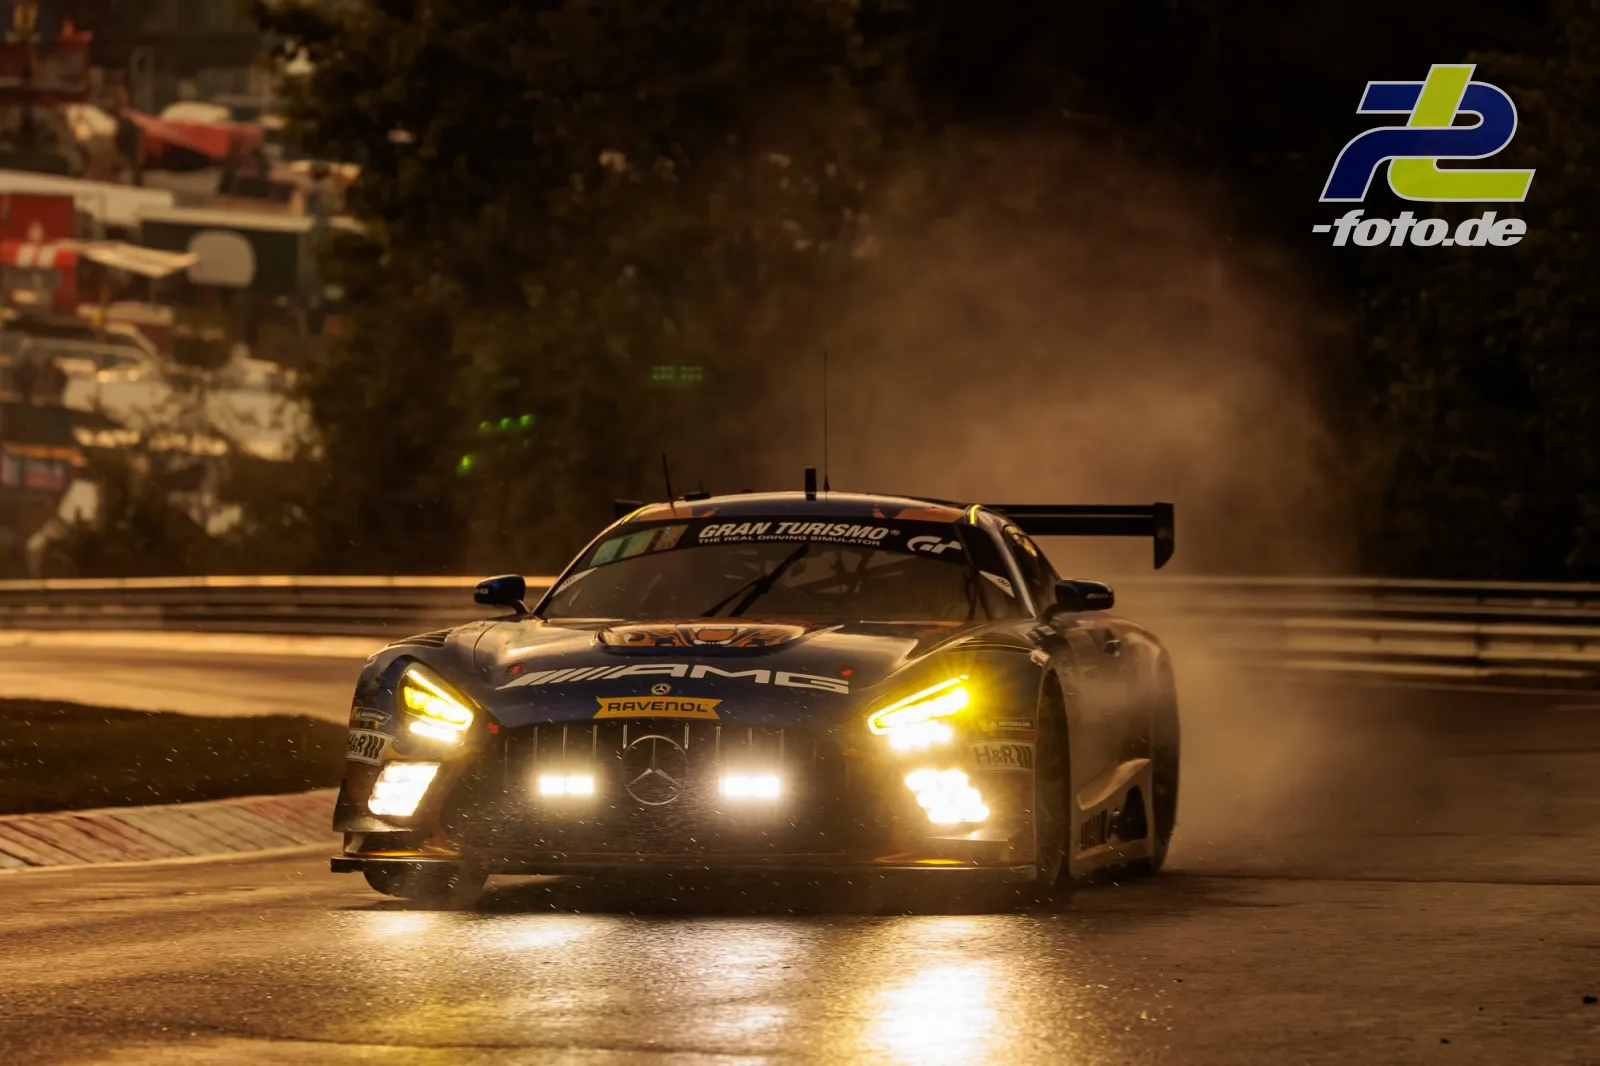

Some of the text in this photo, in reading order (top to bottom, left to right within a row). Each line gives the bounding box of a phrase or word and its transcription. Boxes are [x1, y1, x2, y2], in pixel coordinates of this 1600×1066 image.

[698, 522, 889, 540] GRAN TURISMO
[810, 535, 881, 547] SIMULATOR
[607, 701, 708, 713] RAVENOL
